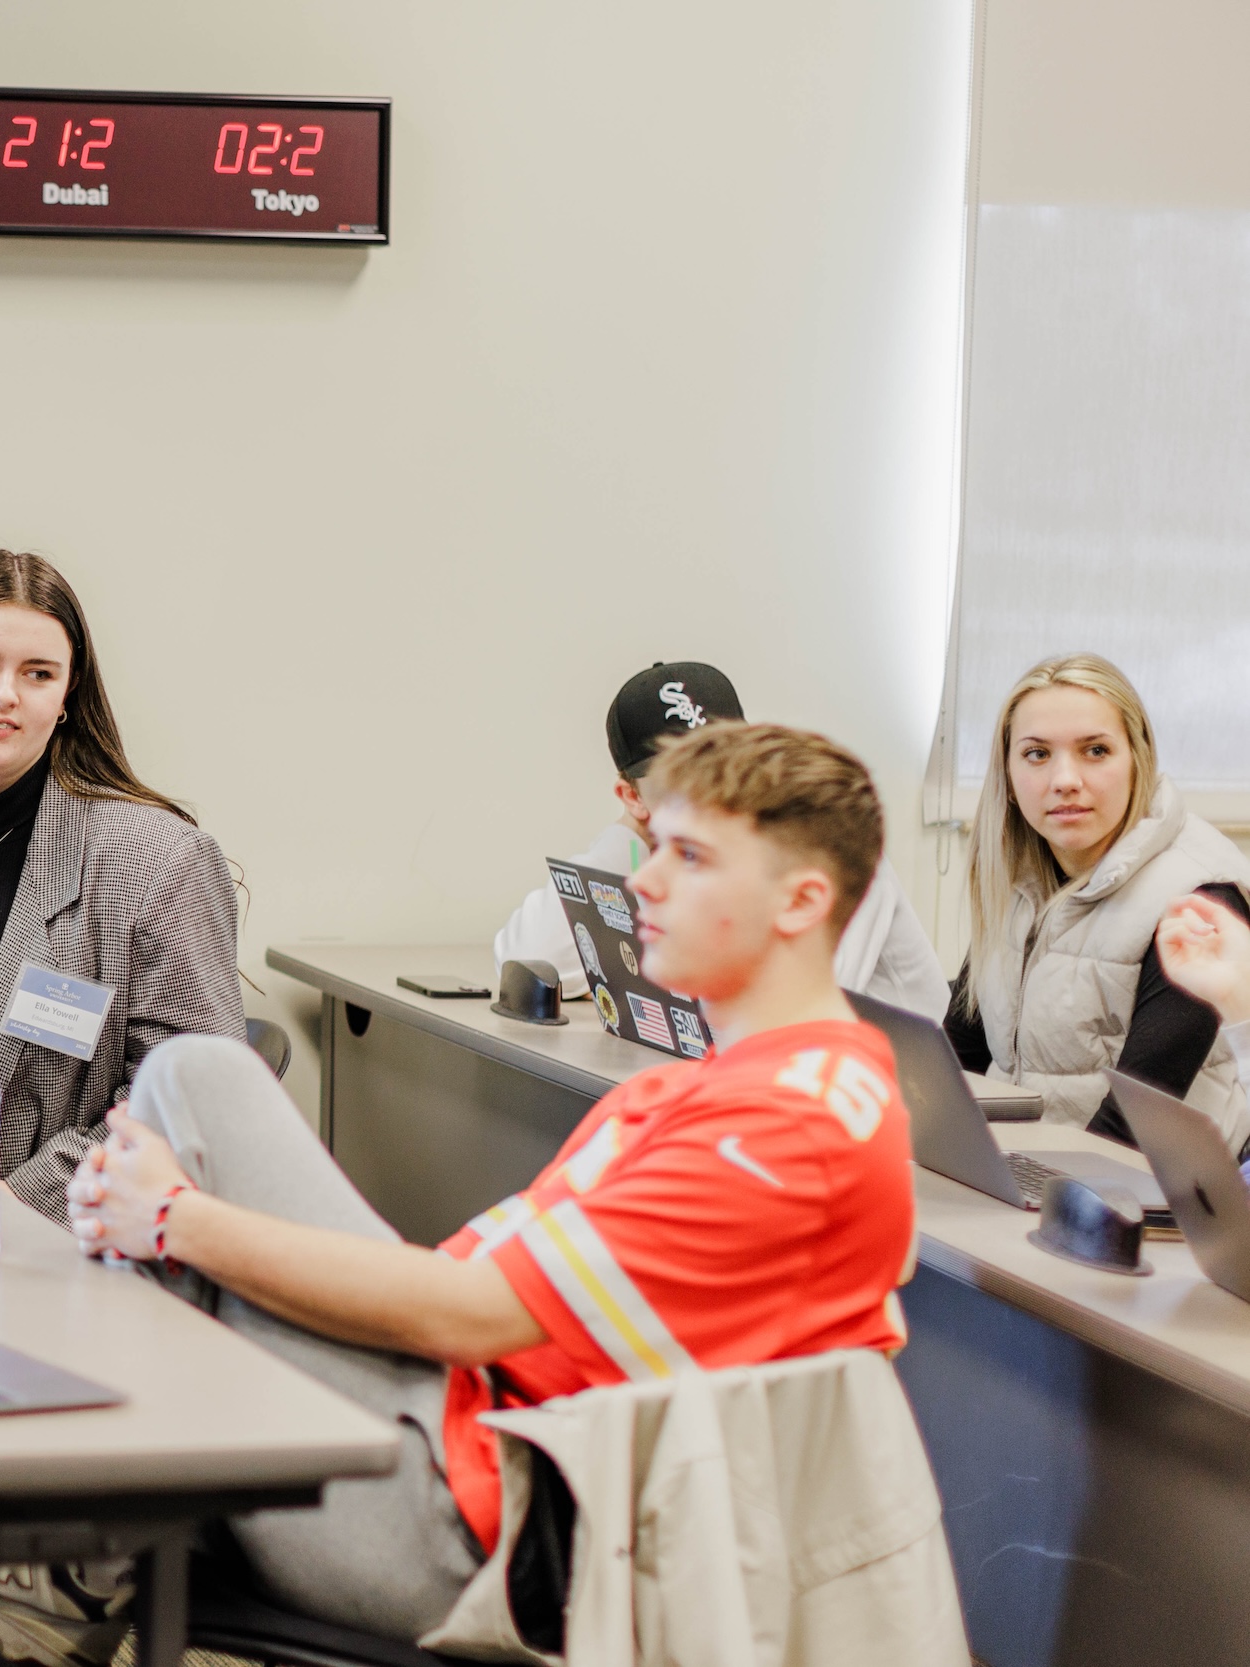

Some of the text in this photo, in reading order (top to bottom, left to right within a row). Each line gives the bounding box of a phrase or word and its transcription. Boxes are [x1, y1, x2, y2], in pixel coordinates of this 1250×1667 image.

[214, 122, 324, 176] 02:2
[43, 183, 108, 205] Dubai
[252, 189, 319, 216] Tokyo
[551, 870, 583, 897] YETI
[45, 984, 81, 1001] Spring Arbor
[35, 1002, 79, 1022] Ella Yowell
[672, 1009, 702, 1041] SAU
[774, 1048, 890, 1141] 15
